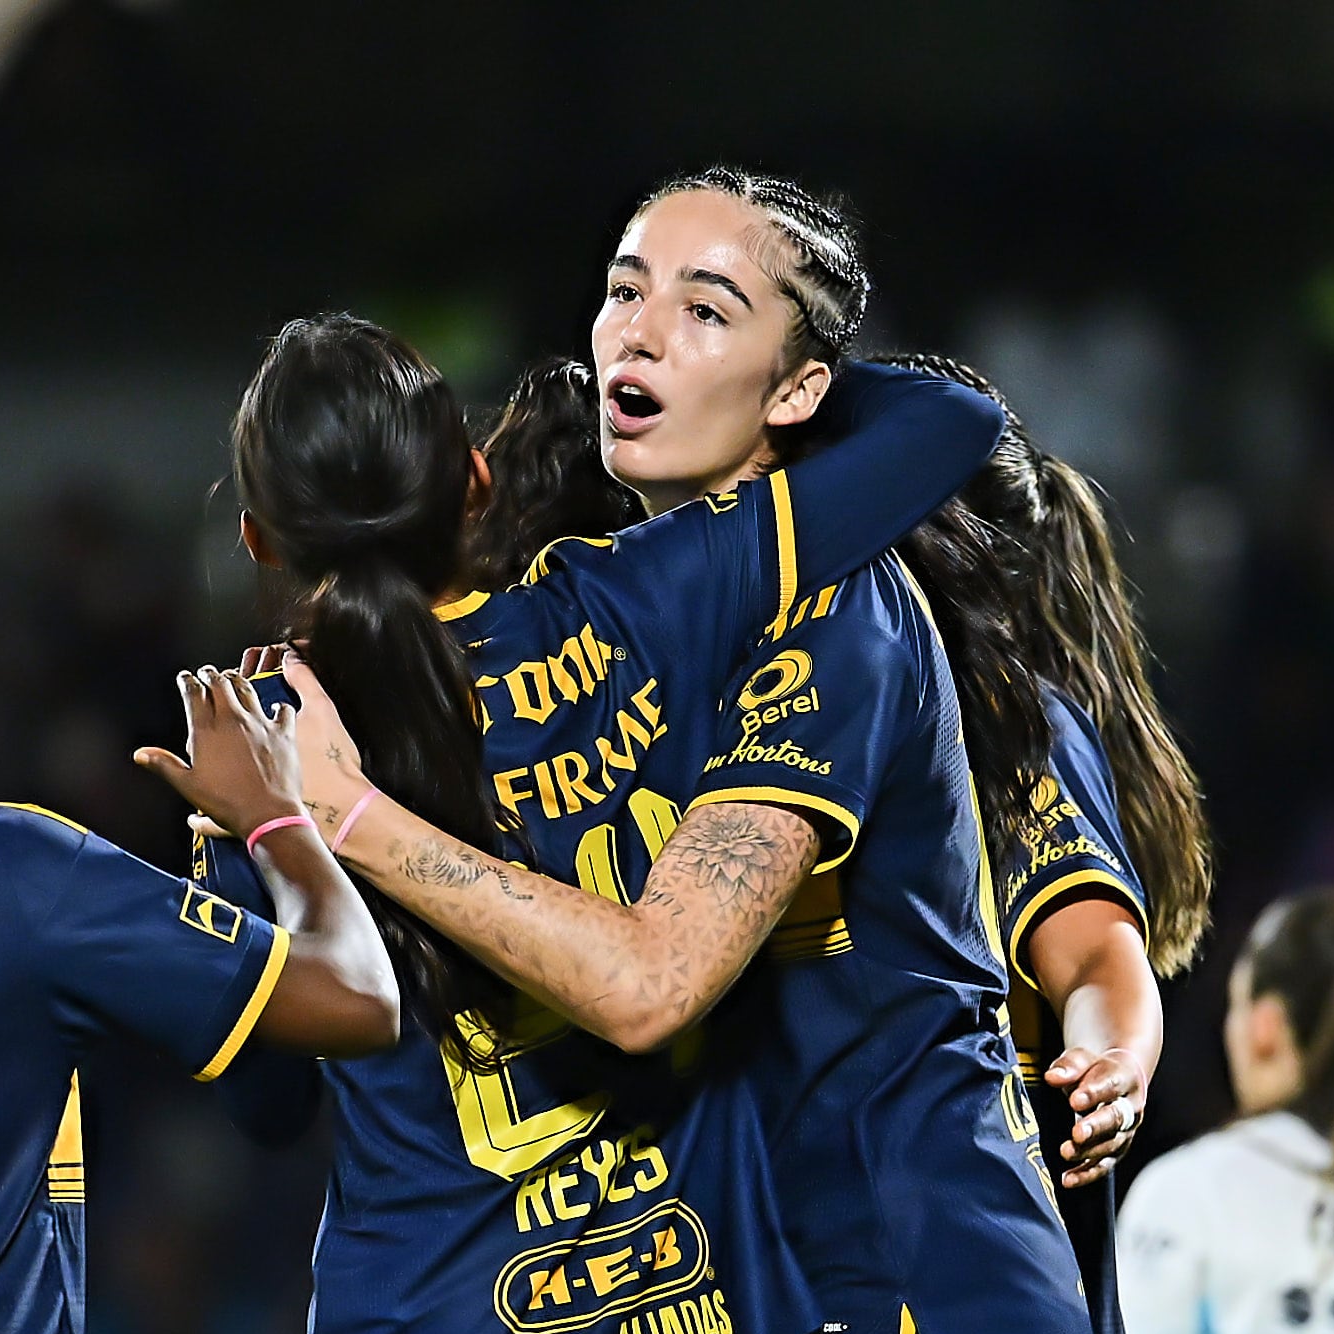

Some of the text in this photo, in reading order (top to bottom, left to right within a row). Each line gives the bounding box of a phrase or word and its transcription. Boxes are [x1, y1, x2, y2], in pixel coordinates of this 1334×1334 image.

[741, 686, 819, 736] Berel
[493, 678, 668, 832] FIRME
[727, 735, 833, 775] Hortons
[528, 1226, 682, 1311] H-E-B
